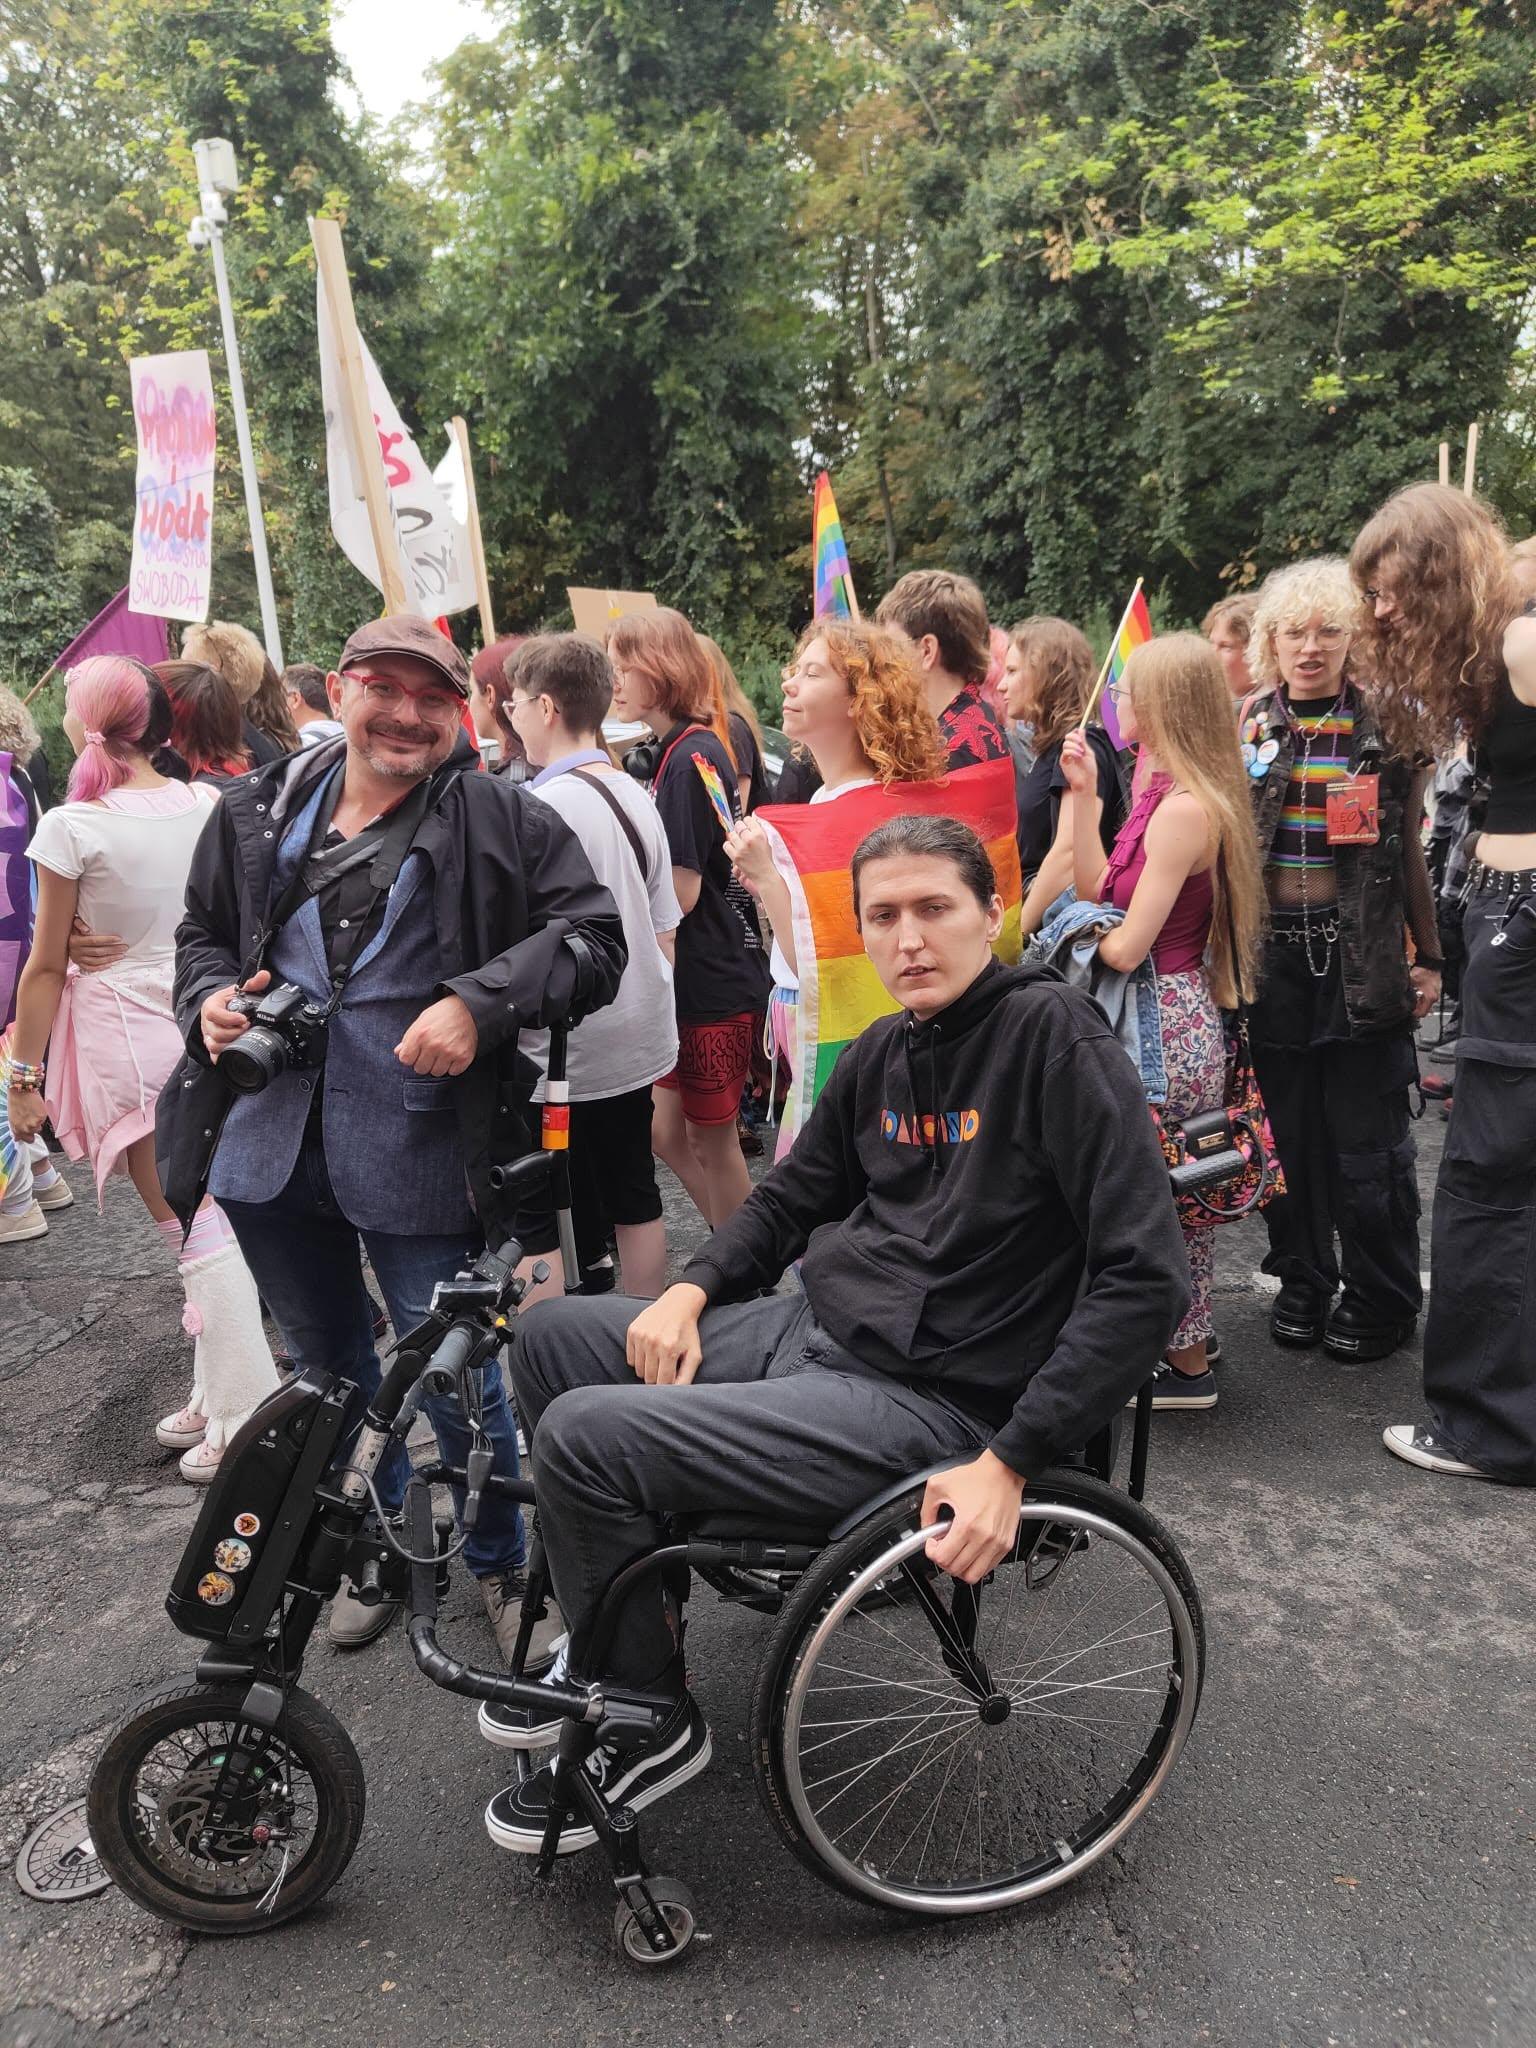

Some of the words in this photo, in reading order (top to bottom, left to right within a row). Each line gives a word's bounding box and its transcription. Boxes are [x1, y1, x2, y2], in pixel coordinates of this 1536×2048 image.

[132, 570, 205, 614] SWOBODA
[256, 1013, 275, 1022] Nikon
[761, 1735, 800, 1842] SCHWALBE
